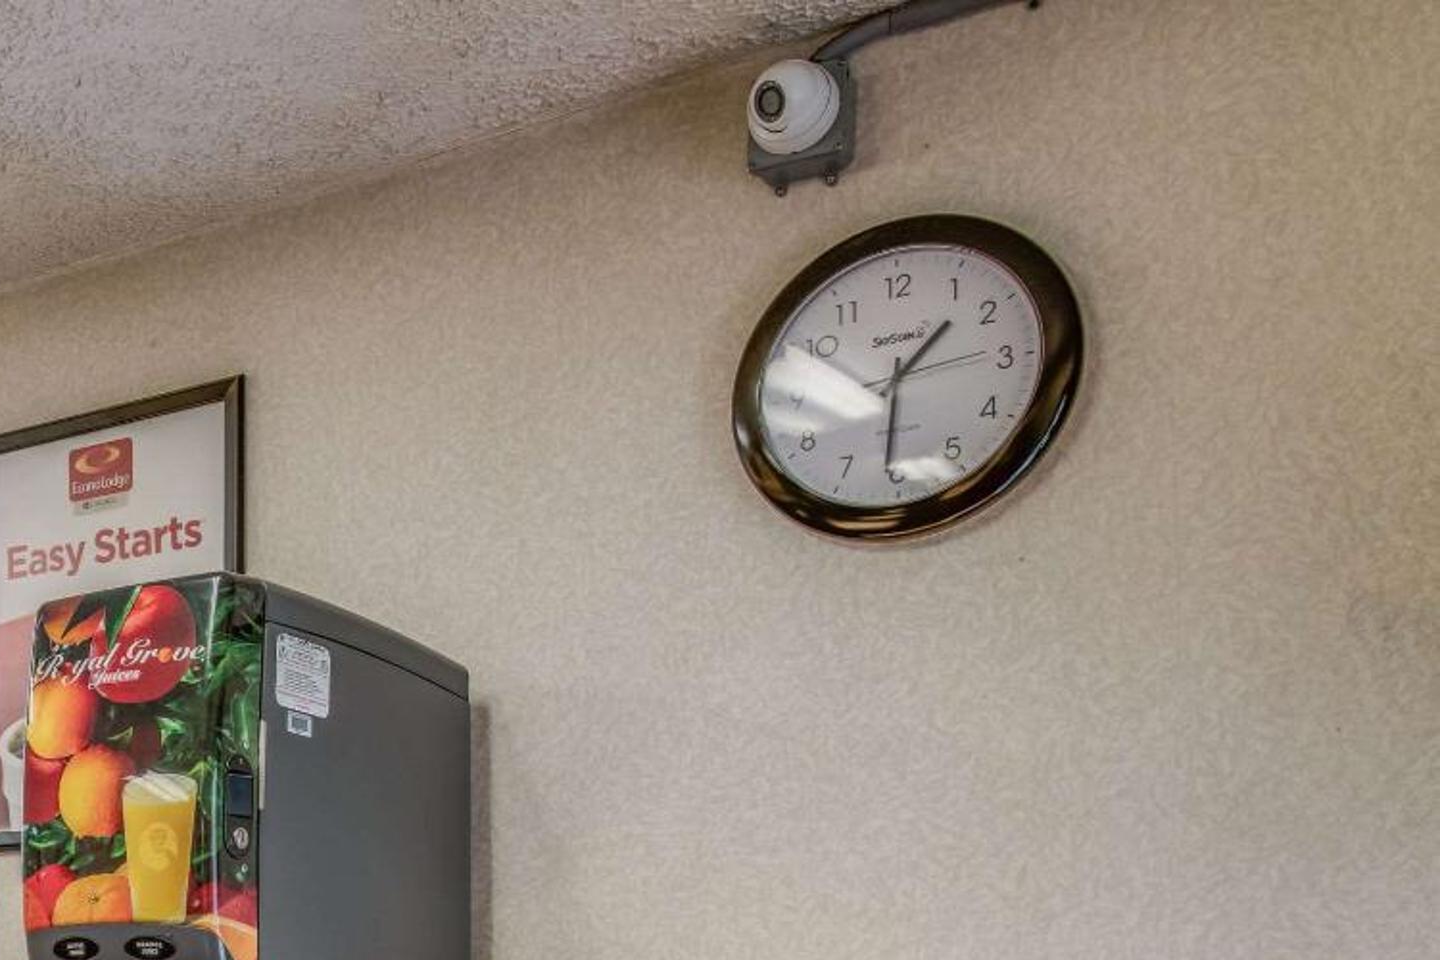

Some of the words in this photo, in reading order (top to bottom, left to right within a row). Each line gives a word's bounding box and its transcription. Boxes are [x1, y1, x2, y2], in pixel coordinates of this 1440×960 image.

[884, 274, 911, 299] 12
[949, 277, 959, 300] 1
[836, 301, 858, 325] 11
[979, 301, 996, 325] 2
[806, 335, 839, 359] 10
[996, 345, 1014, 369] 3
[980, 395, 997, 419] 4
[800, 431, 816, 452] 8
[945, 437, 961, 460] 5
[839, 454, 854, 479] 7
[6, 541, 86, 581] Easy
[94, 516, 203, 564] Starts
